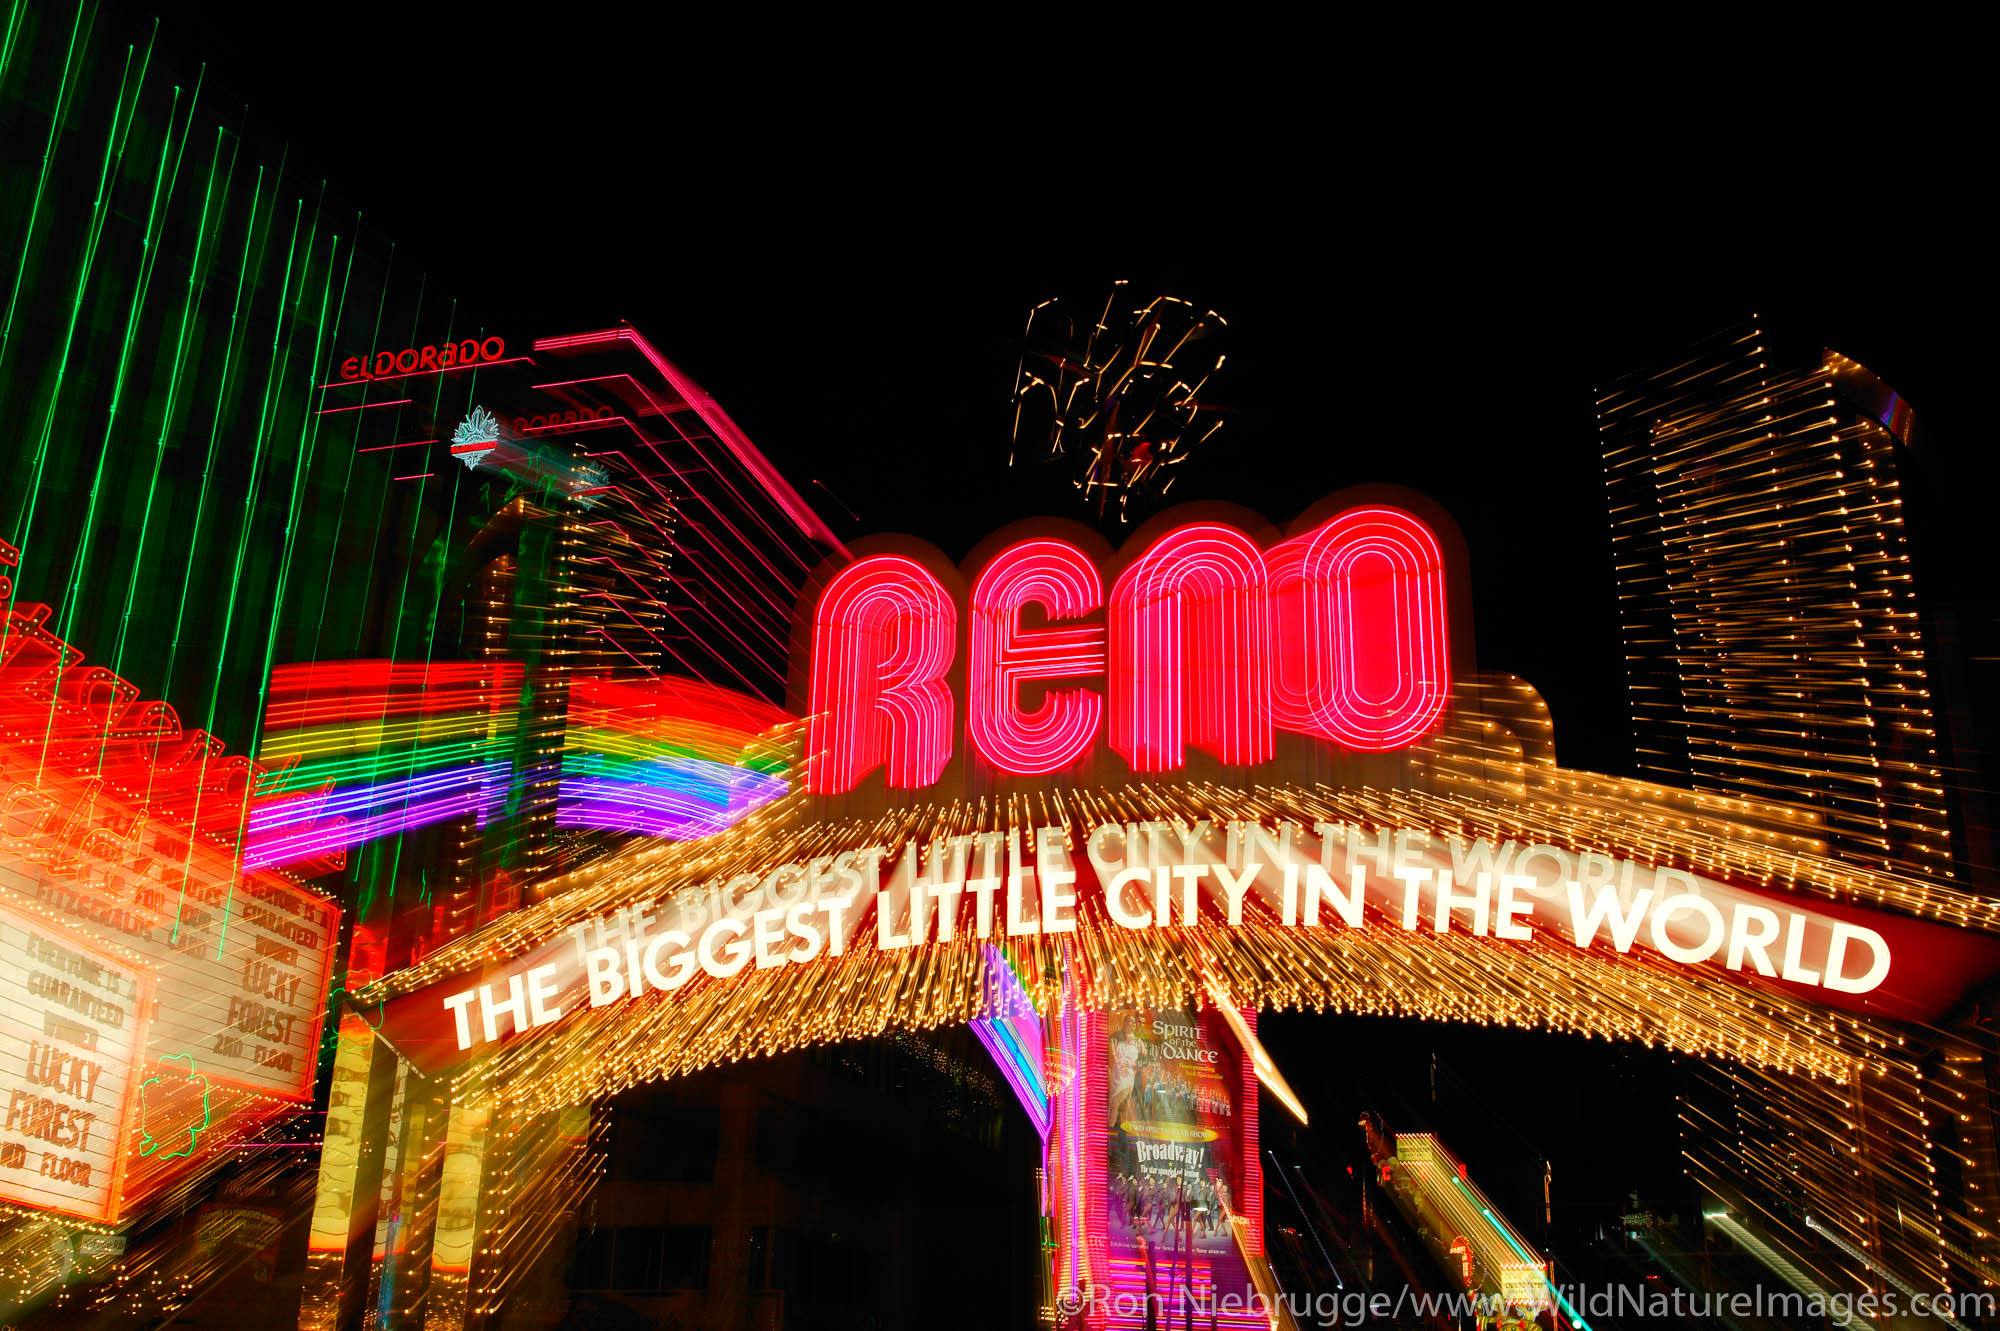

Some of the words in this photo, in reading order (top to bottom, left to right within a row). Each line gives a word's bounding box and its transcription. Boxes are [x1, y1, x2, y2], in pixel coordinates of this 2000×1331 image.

[340, 336, 505, 381] ELDORADO
[806, 504, 1450, 795] RENO
[443, 962, 562, 1052] THE
[585, 899, 852, 1009] BIGGEST
[877, 865, 1076, 951] LITTLE
[1106, 863, 1266, 930] CITY
[1282, 863, 1366, 929] IN
[1397, 866, 1537, 942] THE
[1566, 880, 1891, 995] WORLD
[242, 957, 302, 1008] LUCKY
[226, 994, 297, 1046] FOREST
[1152, 1020, 1204, 1040] SPIRIT
[26, 1040, 102, 1103] LUCKY
[254, 1044, 294, 1073] FLOOR
[1163, 1041, 1219, 1064] DANCE
[5, 1088, 97, 1153] FOREST
[0, 1141, 27, 1170] ND
[40, 1152, 92, 1188] FLOOR
[1136, 1140, 1205, 1169] Broadway!
